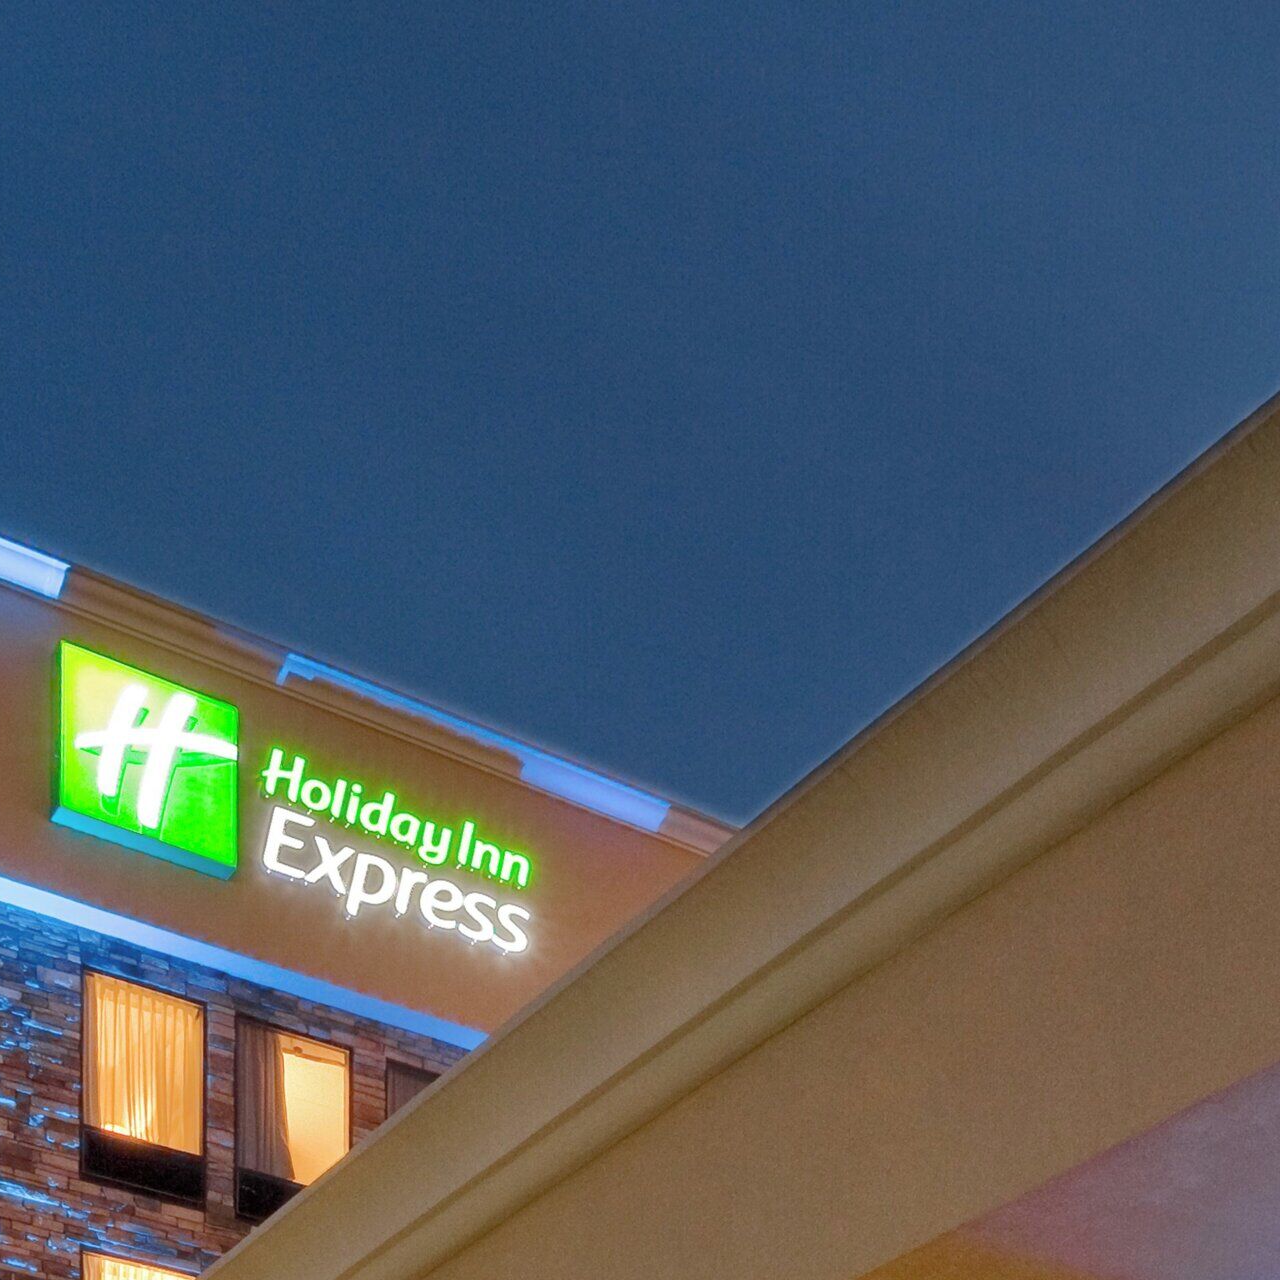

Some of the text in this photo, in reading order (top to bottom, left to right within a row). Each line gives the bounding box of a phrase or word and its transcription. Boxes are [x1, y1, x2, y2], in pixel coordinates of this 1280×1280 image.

[261, 748, 531, 887] Holiday Inn
[261, 806, 531, 953] Express
